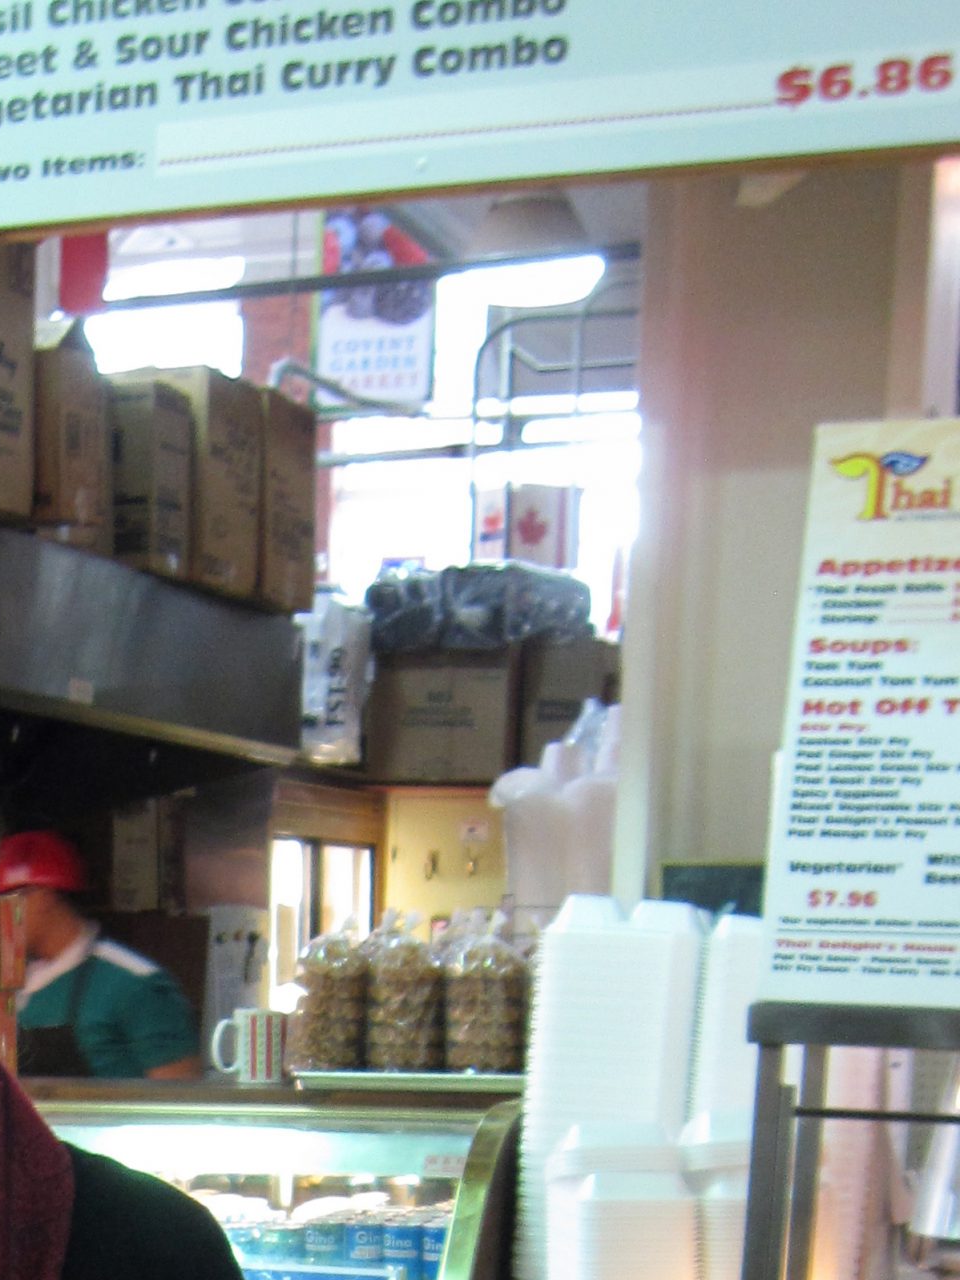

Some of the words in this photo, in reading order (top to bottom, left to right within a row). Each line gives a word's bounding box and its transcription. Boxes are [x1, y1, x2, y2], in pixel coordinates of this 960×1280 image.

[72, 39, 99, 70] &
[115, 29, 210, 65] Sour
[225, 8, 393, 51] Chicken
[411, 0, 567, 30] Combo
[175, 63, 265, 103] Thai
[281, 54, 397, 92] Curry
[413, 35, 570, 77] Combo
[775, 52, 954, 111] $6.86
[41, 150, 145, 180] Items:
